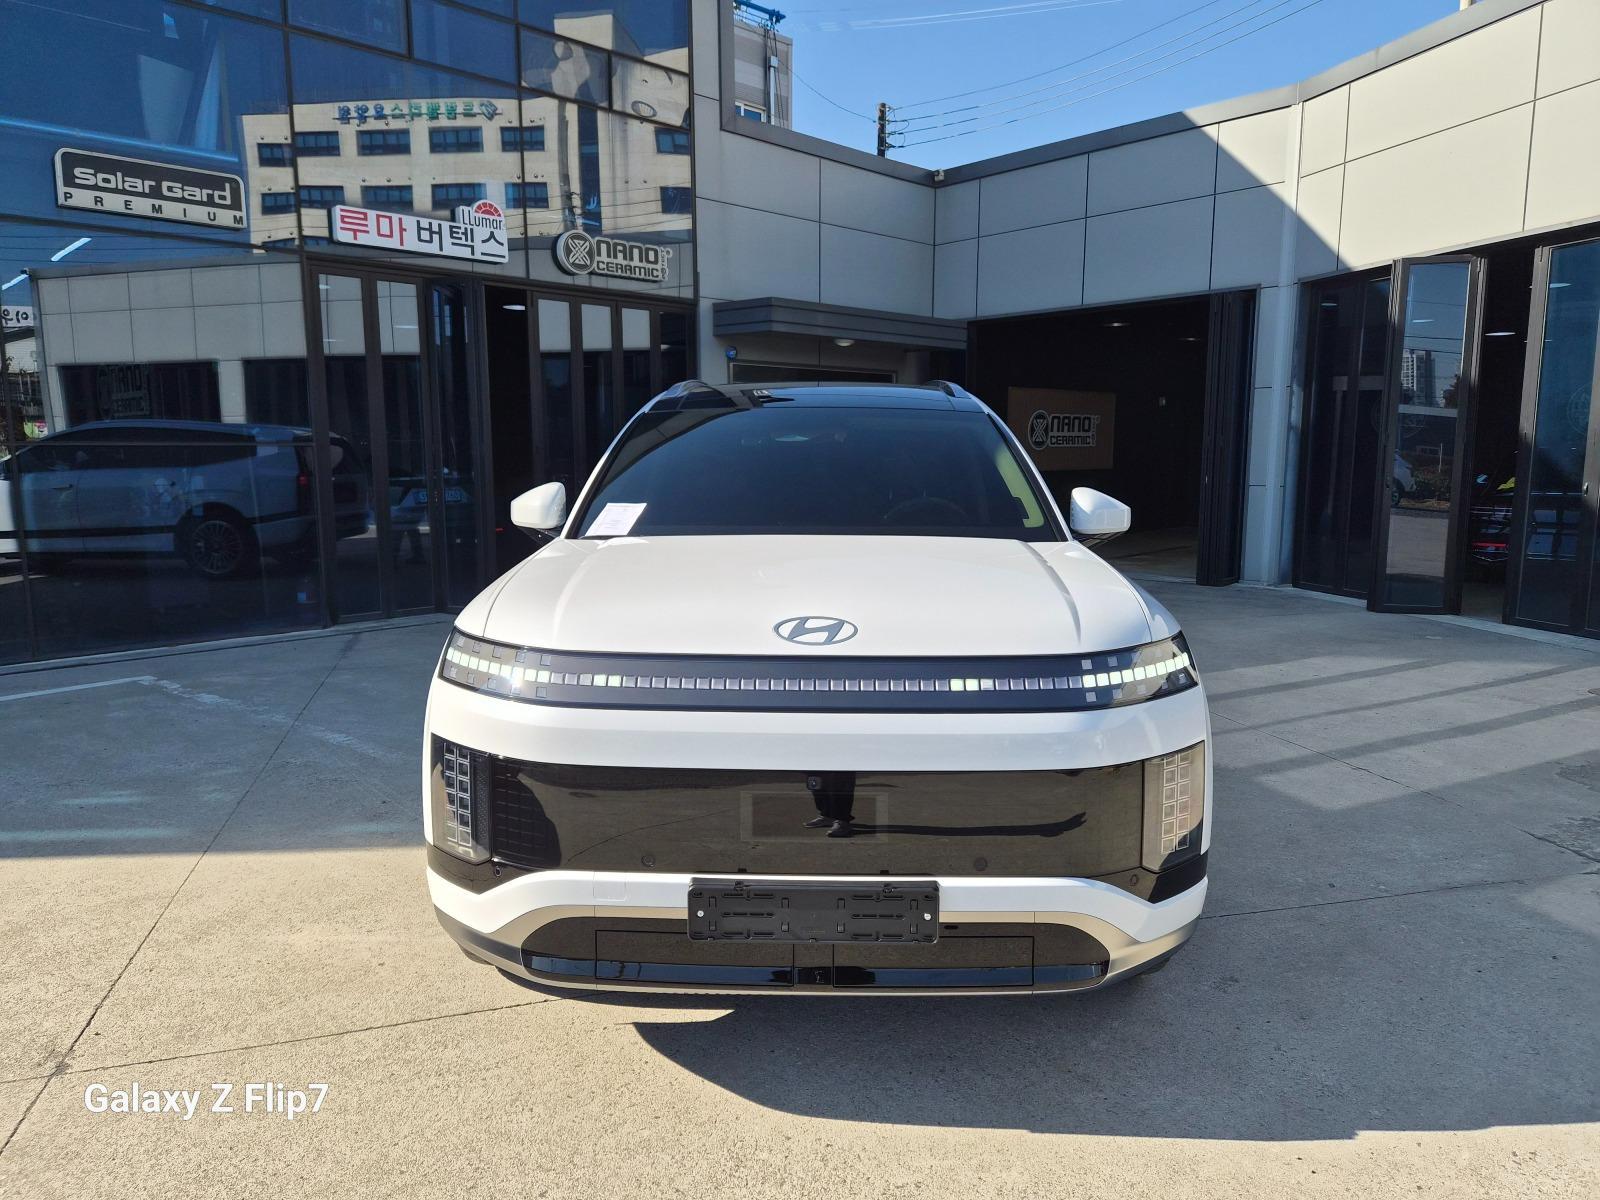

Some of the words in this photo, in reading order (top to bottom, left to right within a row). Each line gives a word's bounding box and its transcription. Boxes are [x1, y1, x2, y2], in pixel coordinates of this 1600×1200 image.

[74, 167, 156, 194] Solar
[161, 181, 232, 206] Gard
[63, 192, 244, 226] PREMIUM
[339, 207, 408, 247] 루마
[416, 218, 506, 260] 버텍스
[595, 239, 660, 266] NANO
[595, 260, 660, 279] CERAMIC
[1050, 415, 1092, 433] NANO
[1050, 435, 1091, 446] CERAMIC
